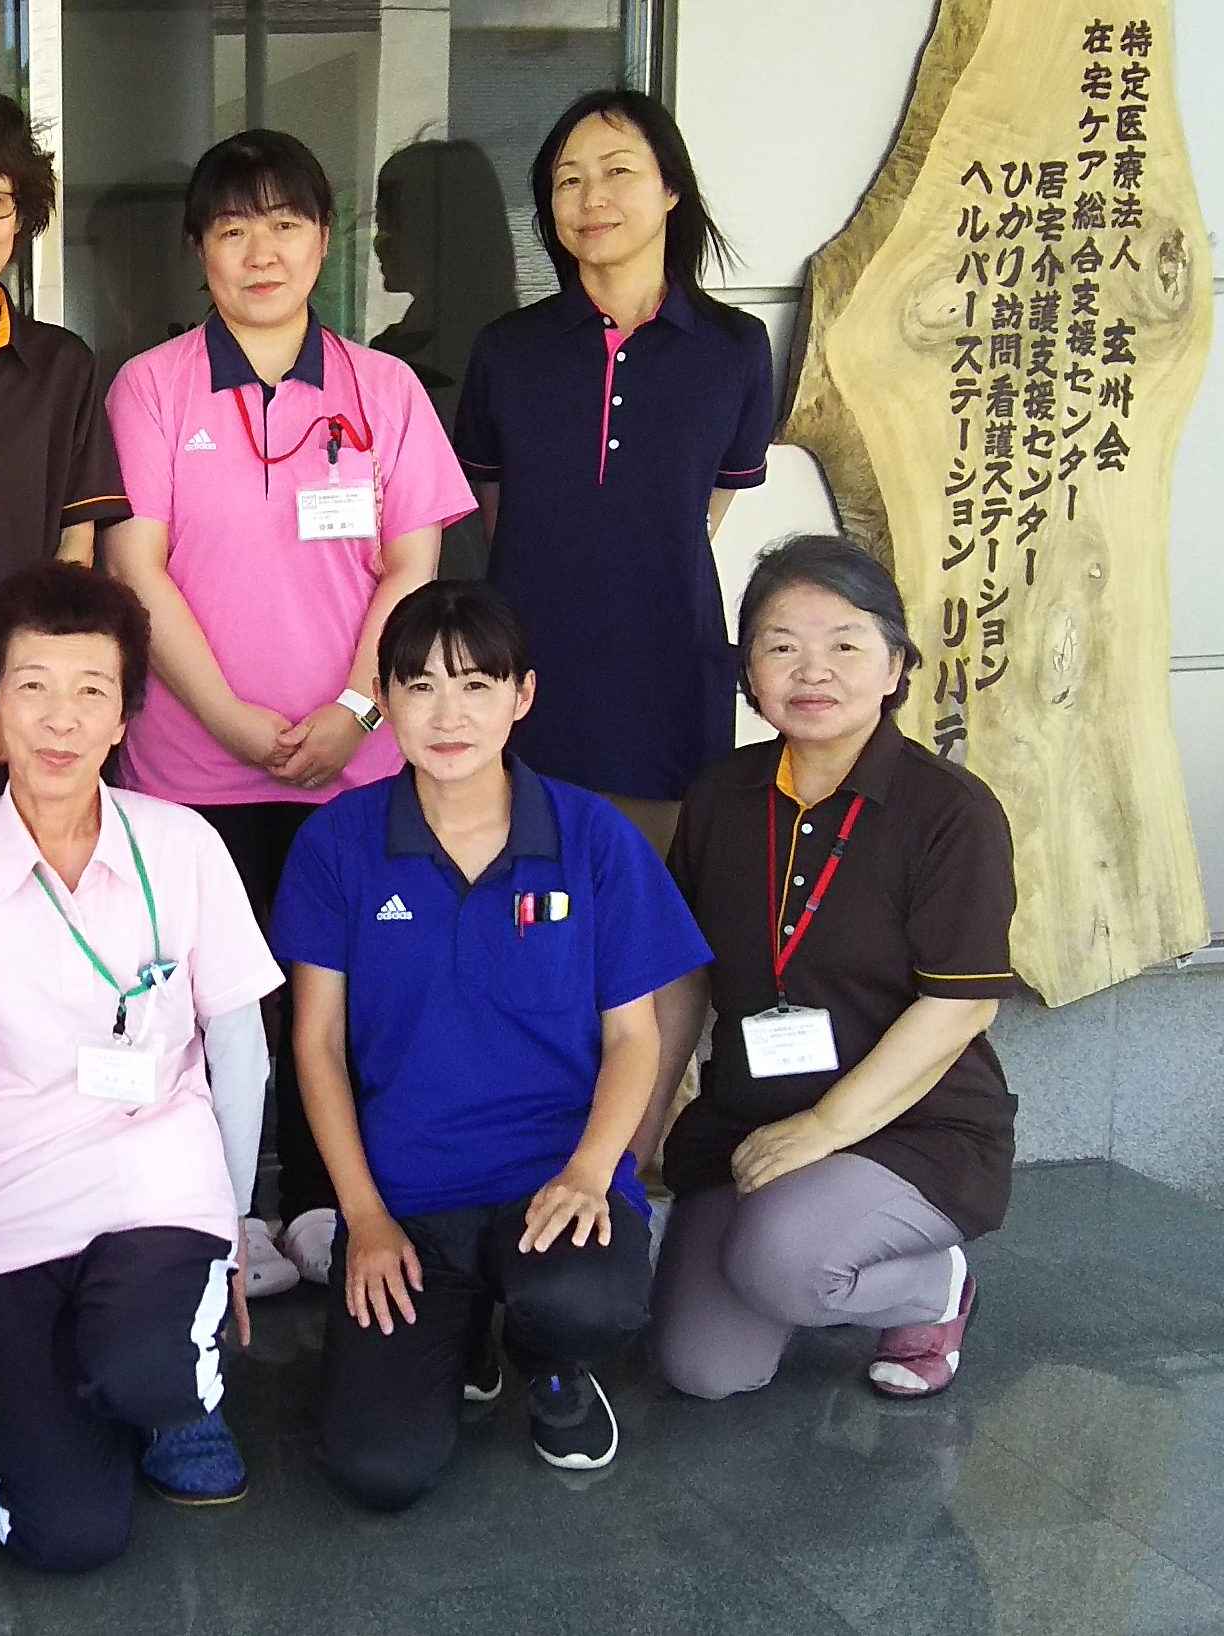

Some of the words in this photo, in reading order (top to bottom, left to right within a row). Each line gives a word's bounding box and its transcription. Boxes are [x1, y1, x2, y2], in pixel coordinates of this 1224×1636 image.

[1059, 18, 1115, 522] 在宅ケア総合支援センター
[1108, 19, 1153, 272] 特定医療法人
[184, 442, 217, 451] adidas
[941, 160, 994, 571] ヘルパーステーション
[975, 161, 1033, 692] ひかり訪問看護ステーション
[1015, 161, 1069, 586] 居宅介護支援センター
[1093, 318, 1137, 473] 玄州会
[376, 911, 413, 921] adidas
